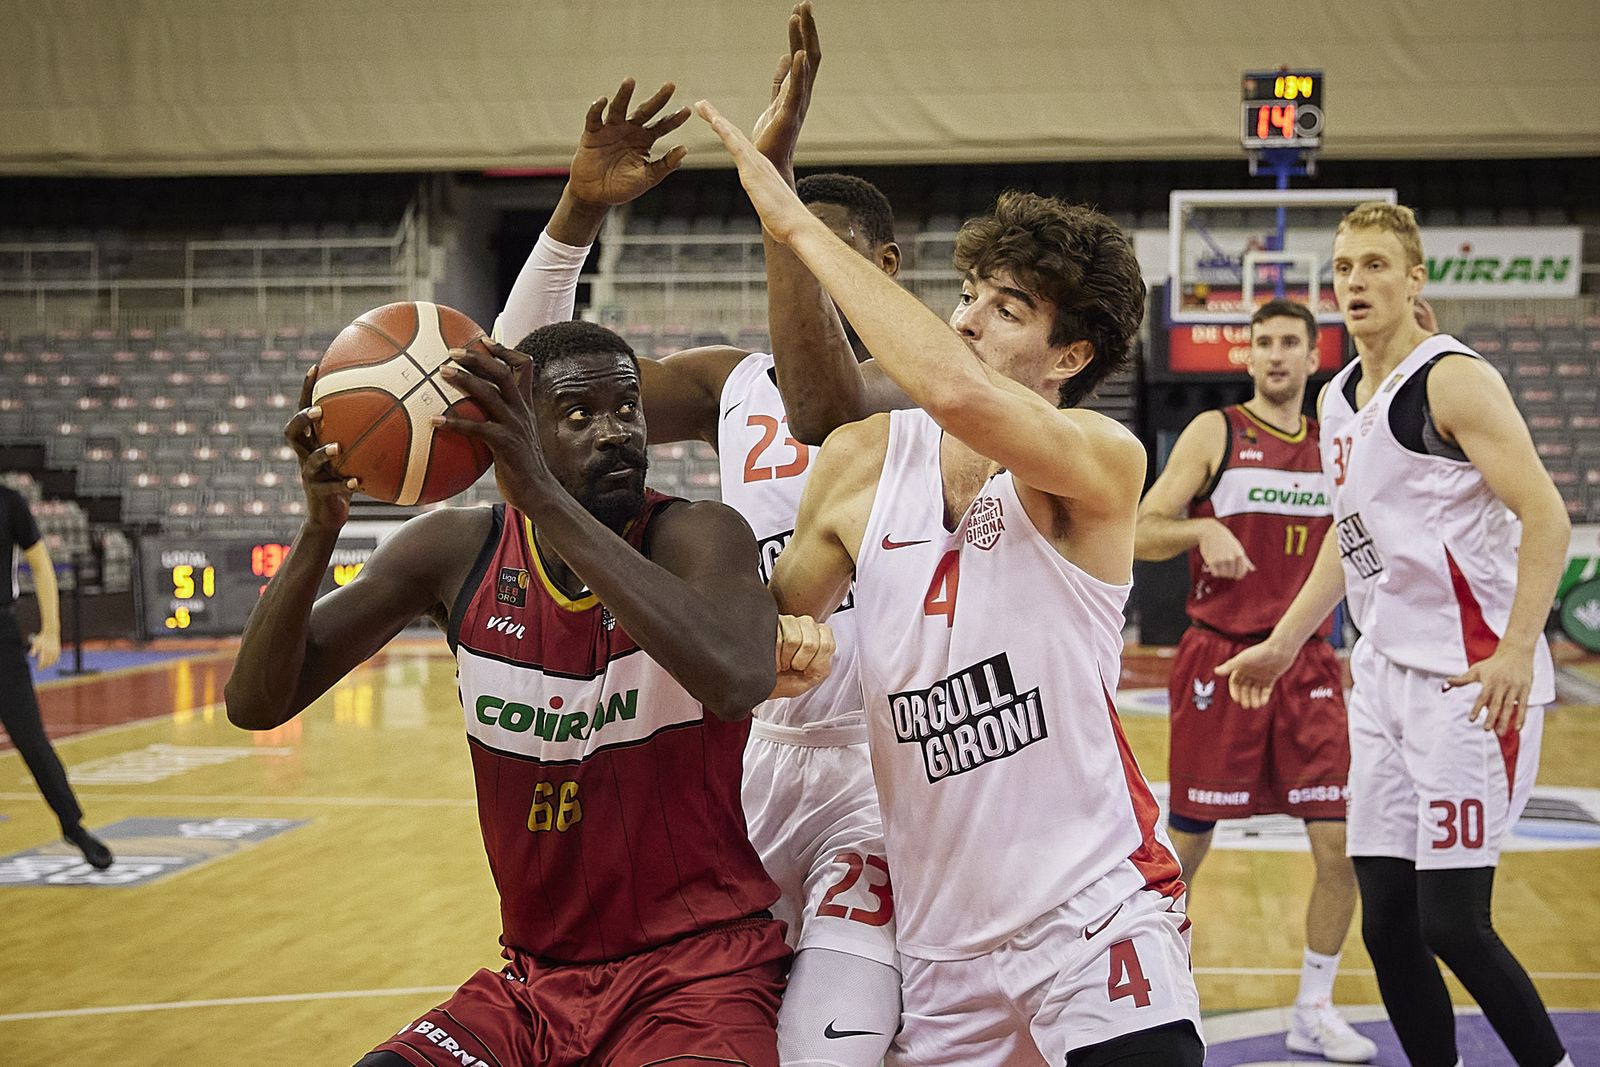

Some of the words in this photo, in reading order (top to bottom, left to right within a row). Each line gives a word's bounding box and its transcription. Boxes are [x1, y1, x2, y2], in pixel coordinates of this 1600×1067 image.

[1257, 104, 1295, 140] 14
[1426, 243, 1570, 282] VIRAN
[743, 415, 809, 484] 23
[966, 517, 1006, 544] GIRONA
[1285, 524, 1309, 556] 17
[172, 564, 214, 599] 51
[497, 594, 517, 604] ORO
[499, 585, 519, 597] LEB
[502, 573, 517, 583] Liga
[923, 550, 960, 628] 4
[893, 662, 1014, 741] ORGULL
[925, 691, 1042, 779] GIRONÍ
[527, 780, 583, 833] 66
[1429, 798, 1484, 850] 30
[815, 852, 894, 927] 23
[1108, 938, 1152, 1008] 4
